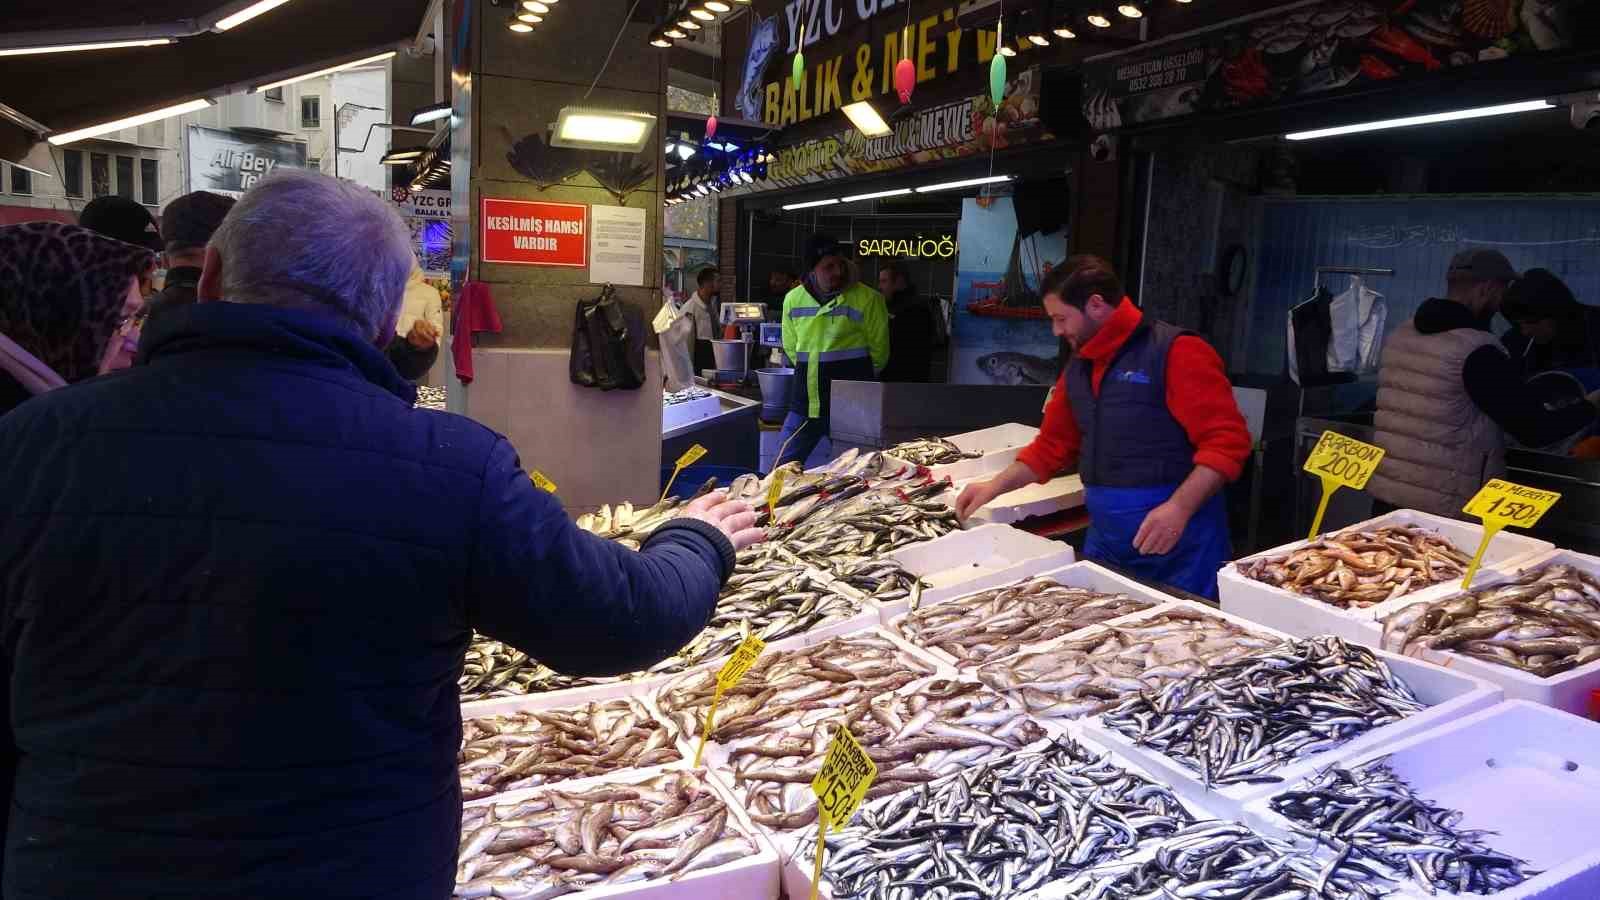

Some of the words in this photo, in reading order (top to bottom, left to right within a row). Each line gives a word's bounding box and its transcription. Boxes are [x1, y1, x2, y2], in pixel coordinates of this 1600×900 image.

[764, 55, 842, 126] BALIK
[852, 44, 875, 101] &
[882, 8, 1031, 95] MEYV
[919, 103, 973, 148] MEYVE
[241, 152, 275, 175] Bey
[412, 196, 433, 206] YZC
[487, 216, 543, 235] KESİLMİŞ
[545, 218, 583, 235] HAMSİ
[513, 236, 557, 251] VARDIR
[859, 235, 960, 257] SARIALİOĞ
